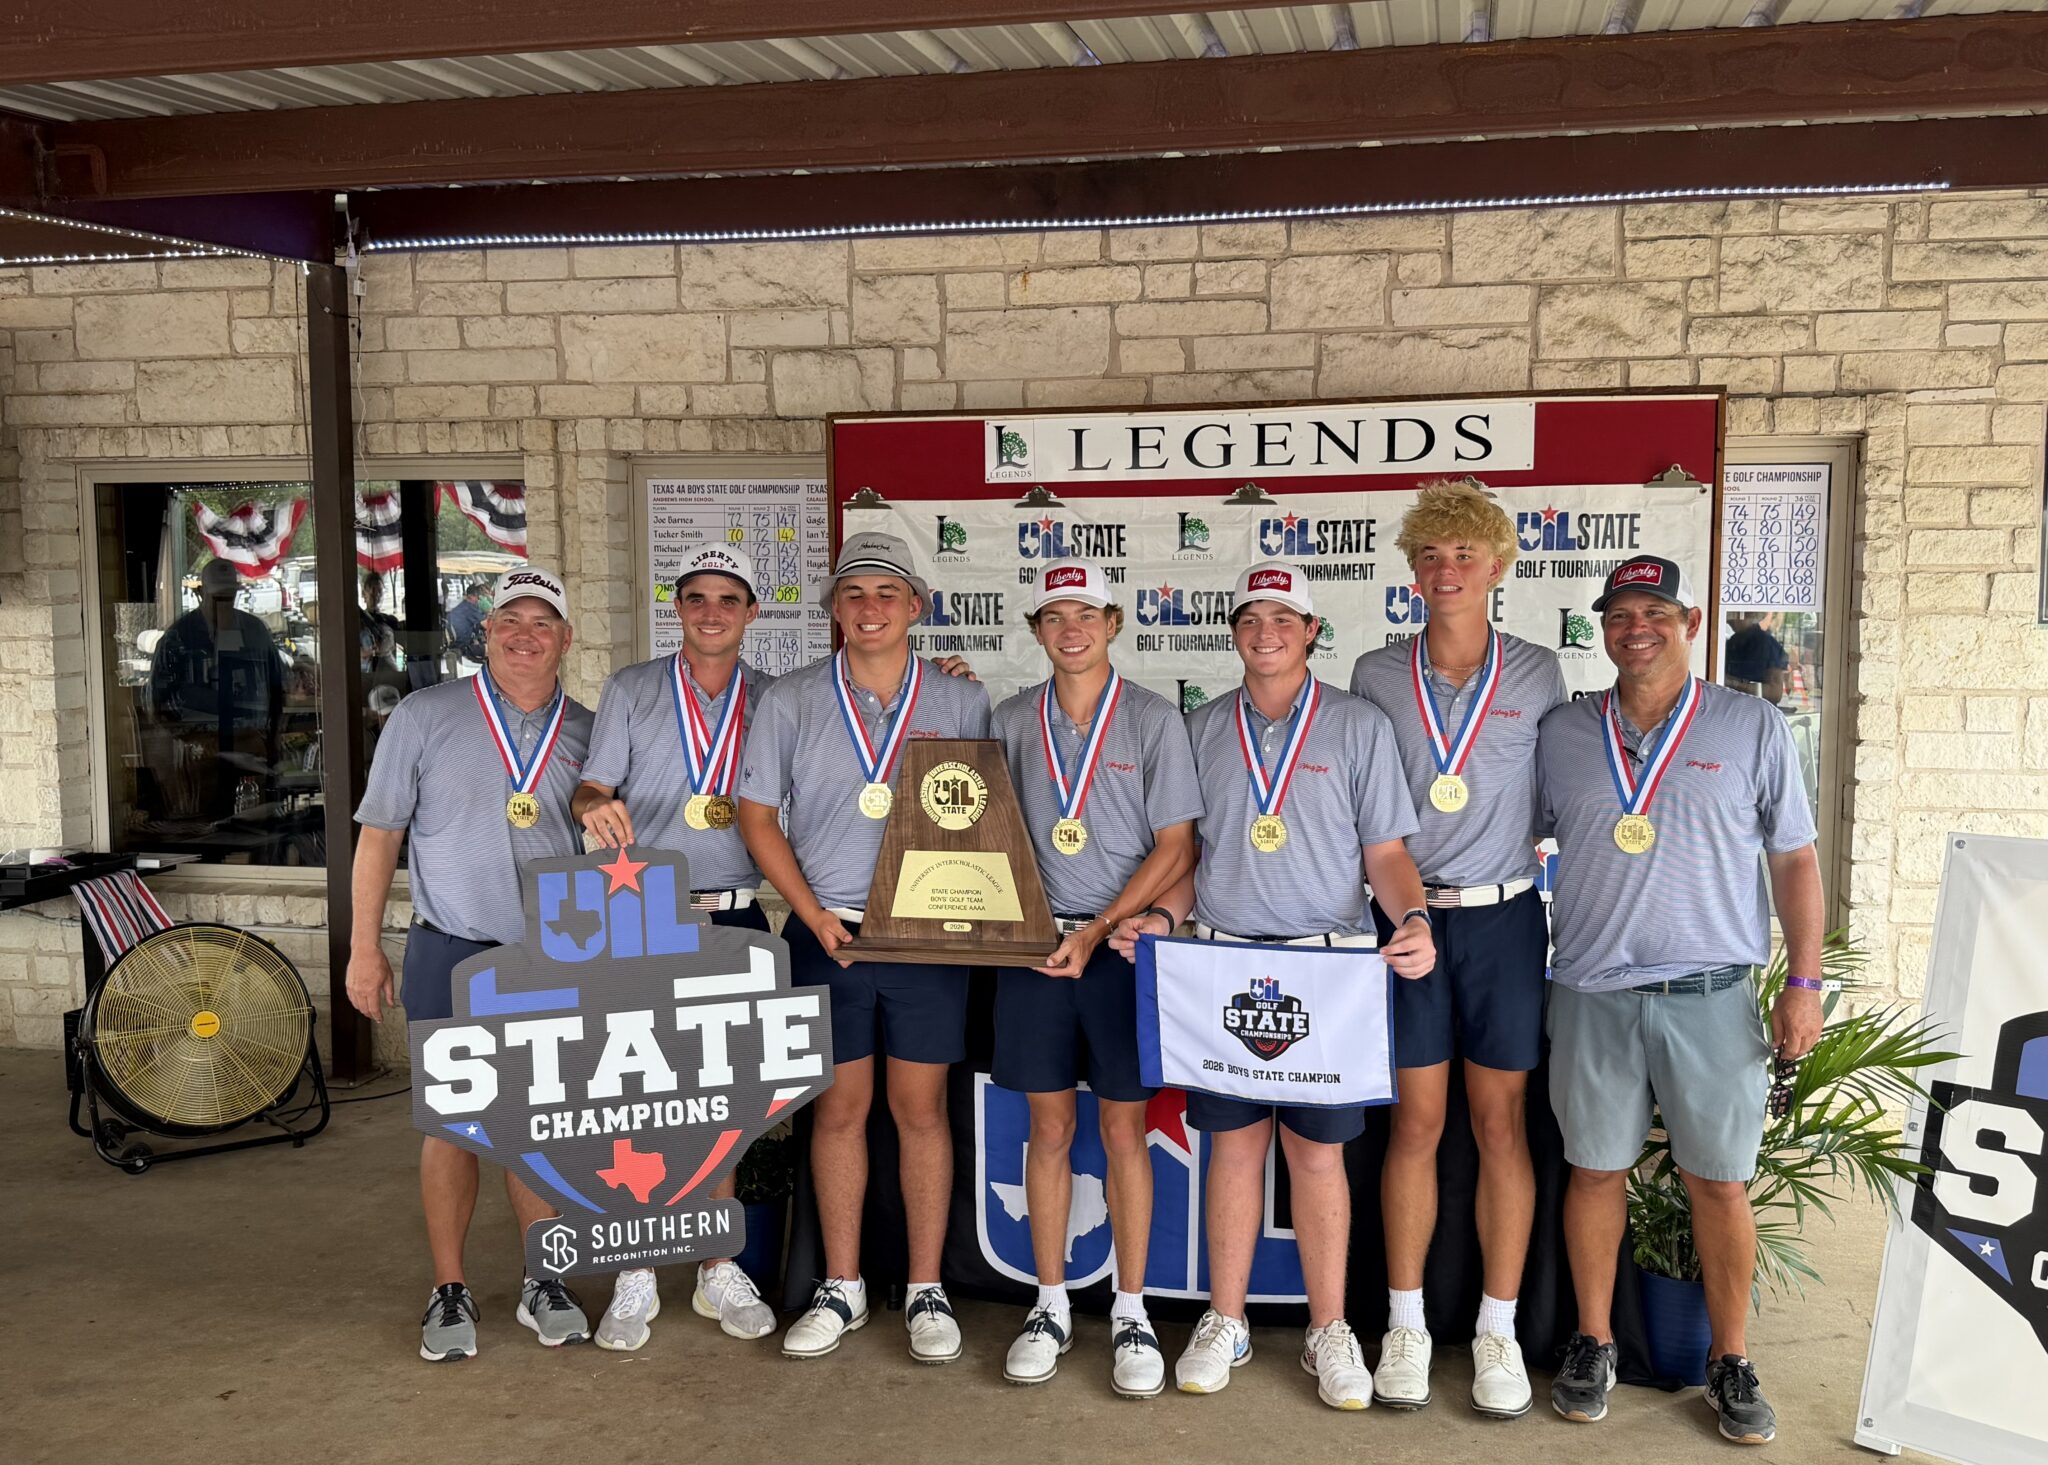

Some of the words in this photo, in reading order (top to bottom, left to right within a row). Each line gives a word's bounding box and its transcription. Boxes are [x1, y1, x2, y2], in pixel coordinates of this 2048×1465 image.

[1068, 413, 1494, 471] LEGENDS
[990, 470, 1032, 479] LEGENDS
[1733, 472, 1755, 482] GOLF
[1757, 472, 1821, 482] CHAMPIONSHIP
[653, 484, 674, 494] TEXAS
[676, 484, 686, 494] 4A
[688, 484, 705, 494] BOYS
[707, 484, 727, 494] STATE
[729, 484, 746, 494] GOLF
[748, 484, 800, 494] CHAMPIONSHIP
[806, 484, 828, 494] TEXAS
[653, 516, 666, 524] Joe
[668, 516, 693, 524] Barnes
[728, 512, 743, 527] 72
[753, 513, 770, 527] 75
[776, 512, 796, 527] 147
[1728, 504, 1749, 520] 74
[1761, 504, 1781, 520] 75
[1791, 504, 1816, 520] 149
[806, 516, 825, 525] Gage
[1728, 521, 1747, 536] 76
[1760, 520, 1782, 536] 80
[1790, 520, 1815, 536] 156
[654, 530, 679, 538] Tucker
[680, 530, 703, 538] Smith
[728, 528, 744, 541] 70
[753, 529, 768, 542] 72
[778, 528, 796, 541] 142
[1315, 519, 1376, 555] STATE
[1577, 513, 1641, 549] STATE
[654, 545, 683, 553] Michael
[777, 542, 799, 556] 149
[807, 545, 829, 553] Austi
[1071, 524, 1126, 558] STATE
[1728, 537, 1747, 553] 74
[1759, 537, 1779, 552] 76
[1789, 536, 1816, 552] 150
[753, 543, 770, 556] 75
[1172, 553, 1214, 561] LEGENDS
[654, 559, 680, 568] Jayden
[690, 550, 739, 569] LIBERTY
[754, 558, 769, 571] 77
[778, 557, 797, 571] 154
[1728, 552, 1748, 568] 85
[1757, 552, 1774, 568] 81
[1789, 552, 1815, 568] 166
[1019, 567, 1038, 584] GO
[1294, 563, 1376, 581] URNAMENT
[1516, 560, 1546, 578] GOLF
[1550, 559, 1626, 579] TOURNAME
[1618, 565, 1657, 581] Liberty
[1727, 568, 1745, 584] 82
[1757, 568, 1779, 585] 86
[1788, 568, 1814, 585] 168
[503, 572, 561, 596] Titleist
[754, 572, 770, 585] 79
[778, 571, 798, 585] 153
[1049, 569, 1084, 586] Liberty
[1252, 572, 1289, 587] Liberty
[655, 583, 675, 602] 2ND
[756, 586, 774, 601] 99
[776, 586, 799, 602] 589
[1721, 585, 1751, 603] 306
[1754, 585, 1780, 604] 312
[1784, 585, 1811, 604] 618
[950, 592, 1004, 626] STATE
[1190, 591, 1235, 625] STAT
[1385, 586, 1430, 624] UI
[655, 609, 677, 619] TEXAS
[757, 610, 801, 619] AMPIONSHIP
[808, 610, 830, 619] TEXAS
[656, 640, 676, 648] Caleb
[755, 639, 771, 651] 75
[778, 638, 798, 652] 148
[808, 641, 831, 649] Jaxon
[907, 634, 925, 651] OLF
[928, 634, 1004, 651] TOURNAMENT
[1137, 634, 1164, 652] GOLF
[1167, 634, 1235, 652] TOURNAME
[755, 652, 768, 666] 81
[1309, 652, 1338, 660] ENDS
[910, 865, 935, 892] UNIVERSITY
[935, 859, 986, 875] INTERSCHOLASTIC
[986, 873, 1004, 895] LEAGUE
[1256, 1002, 1279, 1010] GOLF
[1225, 1008, 1307, 1033] STATE
[1240, 1029, 1292, 1040] CHAMPIONSHIPS
[422, 995, 823, 1116] STATE
[1202, 1059, 1224, 1073] 2026
[1228, 1063, 1250, 1078] BOYS
[1253, 1070, 1284, 1082] STATE
[1288, 1072, 1341, 1084] CHAMPION
[529, 1095, 730, 1141] CHAMPIONS
[592, 1208, 730, 1249] SOUTHERN
[593, 1248, 668, 1264] RECOGNITION
[672, 1244, 695, 1255] INC.
